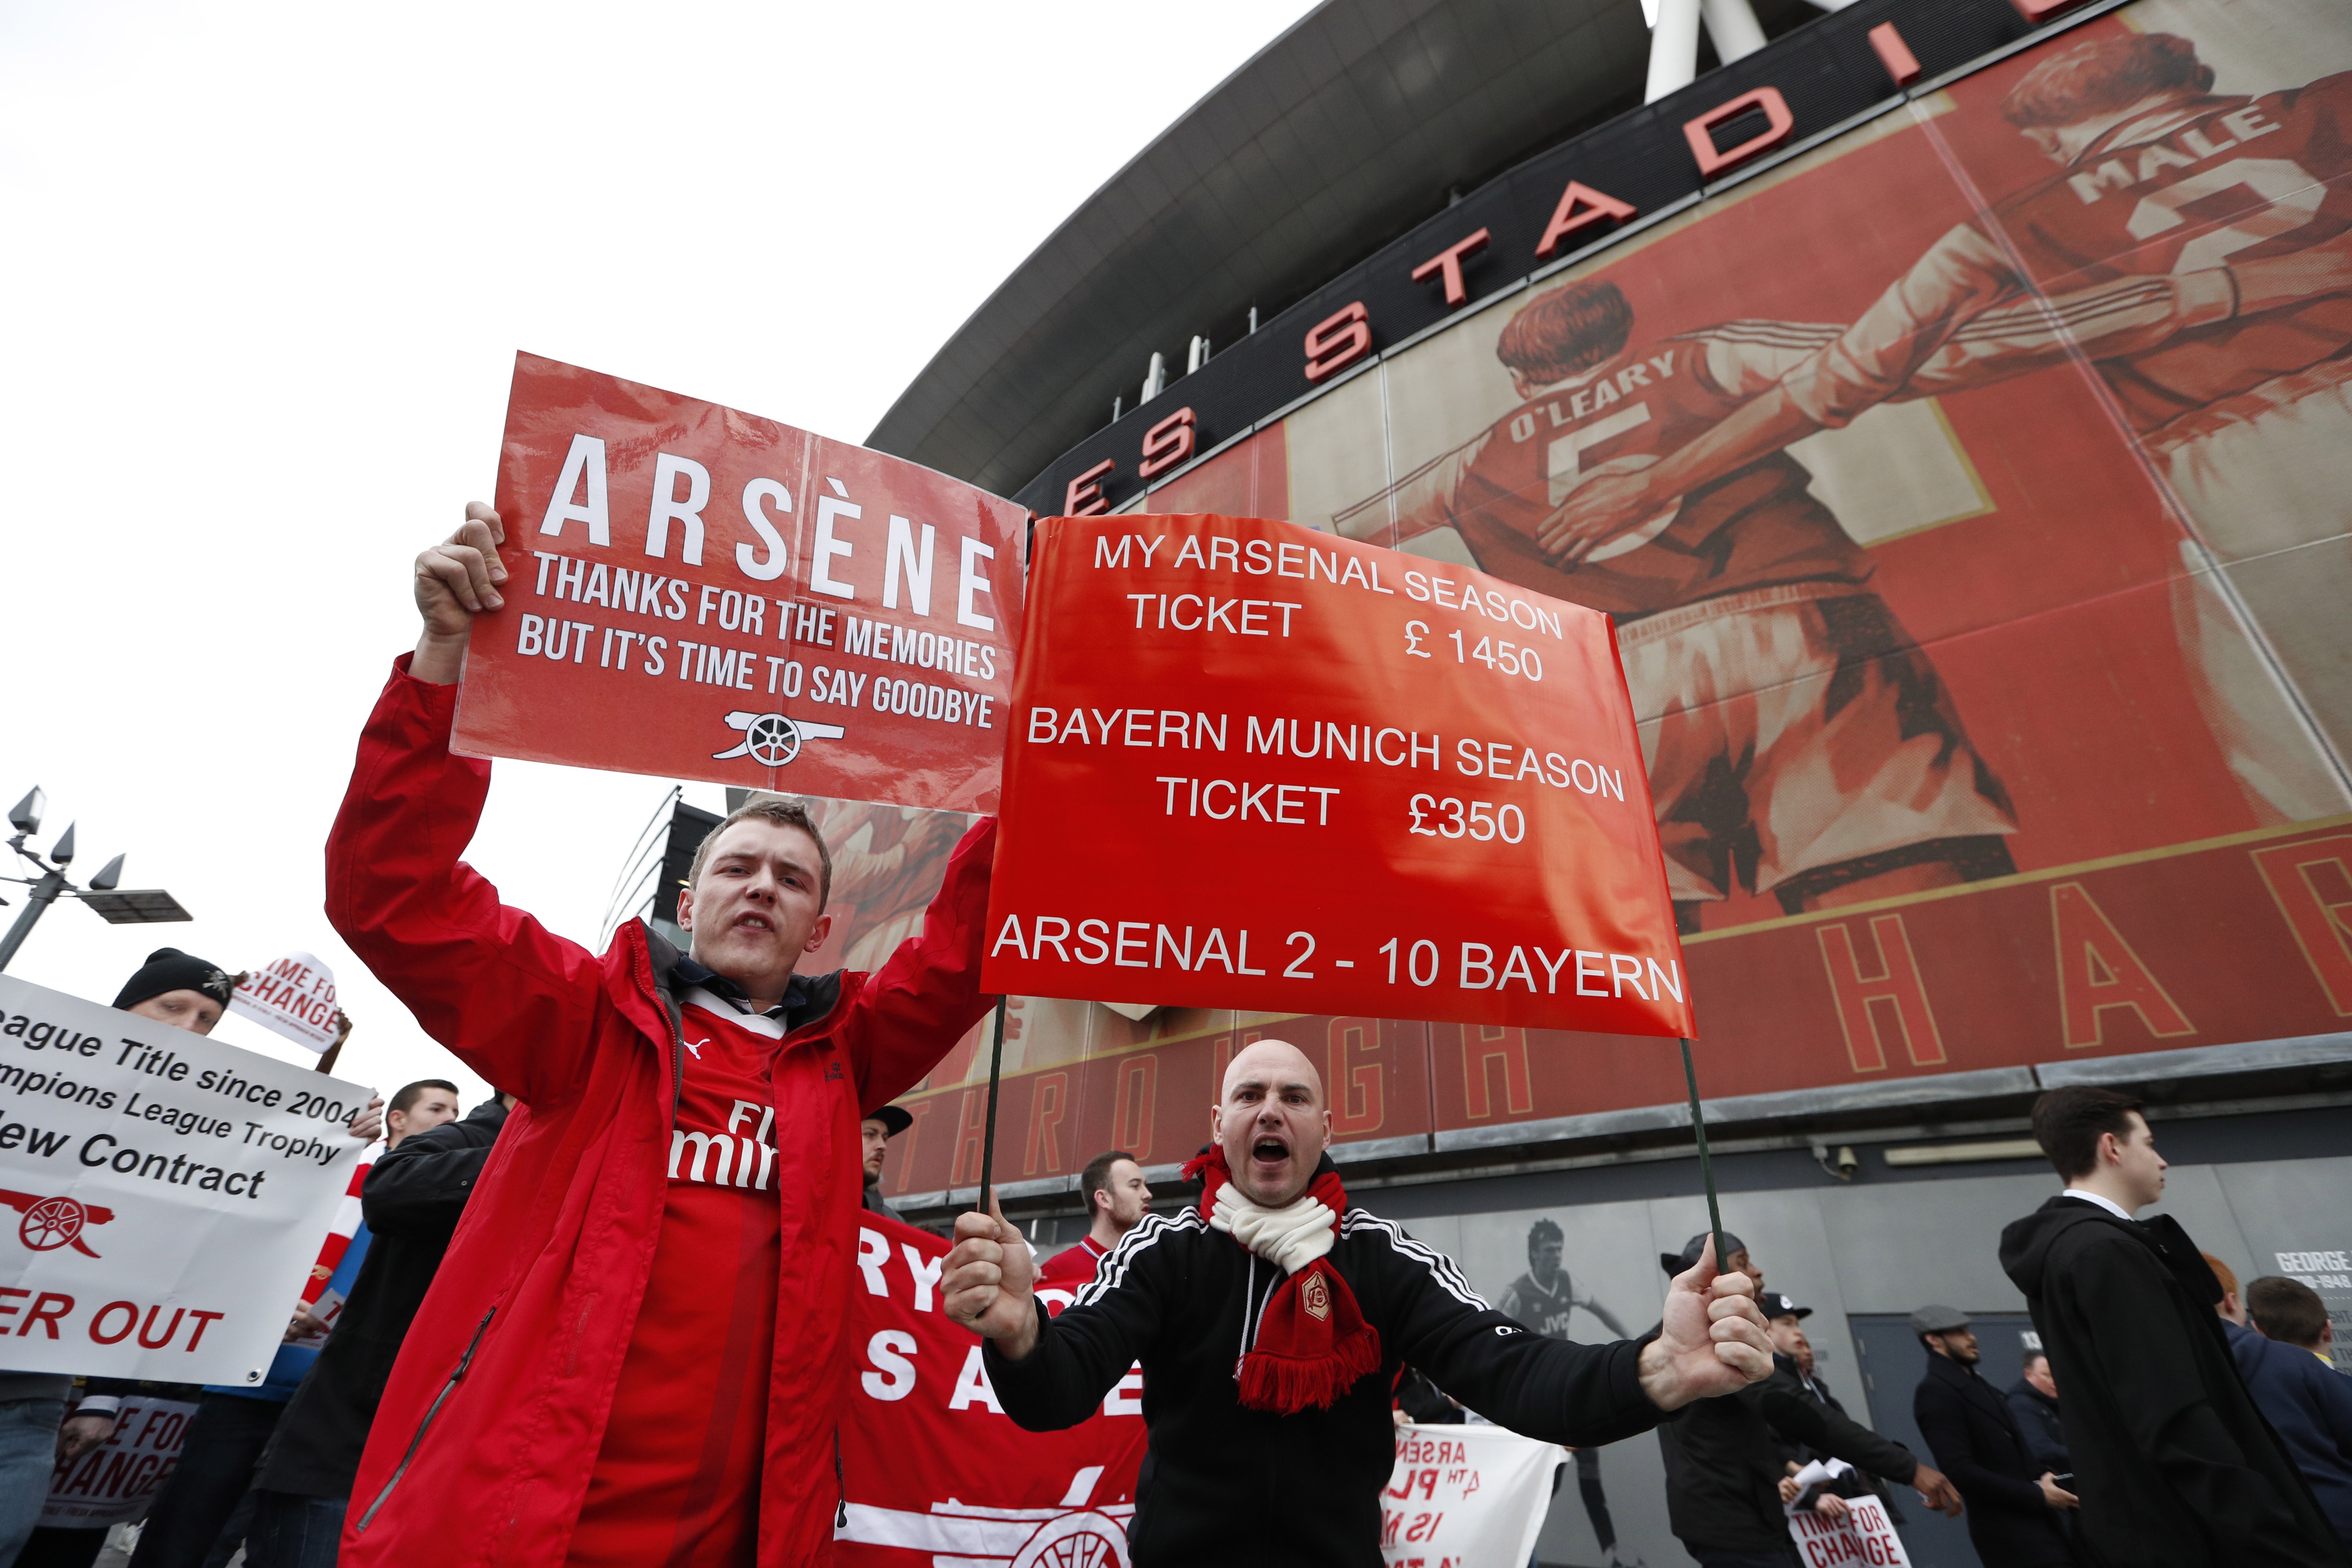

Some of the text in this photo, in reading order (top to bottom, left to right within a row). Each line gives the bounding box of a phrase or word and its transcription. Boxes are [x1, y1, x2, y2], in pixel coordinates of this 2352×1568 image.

[2067, 105, 2282, 205] MALE
[1028, 0, 2098, 521] ES STADI
[1510, 349, 1675, 443] O'LEARY
[538, 432, 995, 632] ARSÈNE
[533, 551, 995, 680] THANKS FOR THE MEMORIES
[1094, 535, 1563, 640] MY ARSENAL SEASON
[1127, 594, 1302, 637] TICKET
[517, 613, 994, 729] BUT IT'S TIME TO SAY GOODBYE
[1404, 620, 1543, 683] £ 1450
[1027, 707, 1625, 802] BAYERN MUNICH SEASON
[1156, 776, 1525, 844] TICKET £350
[312, 977, 337, 1007] FO
[991, 914, 1266, 976] ARSENAL
[1283, 931, 1315, 979] 2
[1379, 937, 1439, 986] 10
[1460, 942, 1684, 1003] BAYERN
[236, 971, 340, 1034] CHANGE
[0, 1009, 360, 1128] ague Title since 2004
[0, 1110, 266, 1199] ew Contract
[123, 1092, 233, 1138] League
[242, 1121, 341, 1166] Trophy
[729, 1099, 778, 1148] Fl
[667, 1130, 781, 1190] mir
[2275, 1251, 2352, 1272] GEORGE
[88, 1301, 224, 1352] OUT
[51, 1450, 179, 1498] HANGE
[1792, 1505, 1886, 1537] TIME FOR
[1807, 1534, 1901, 1568] CHANGE
